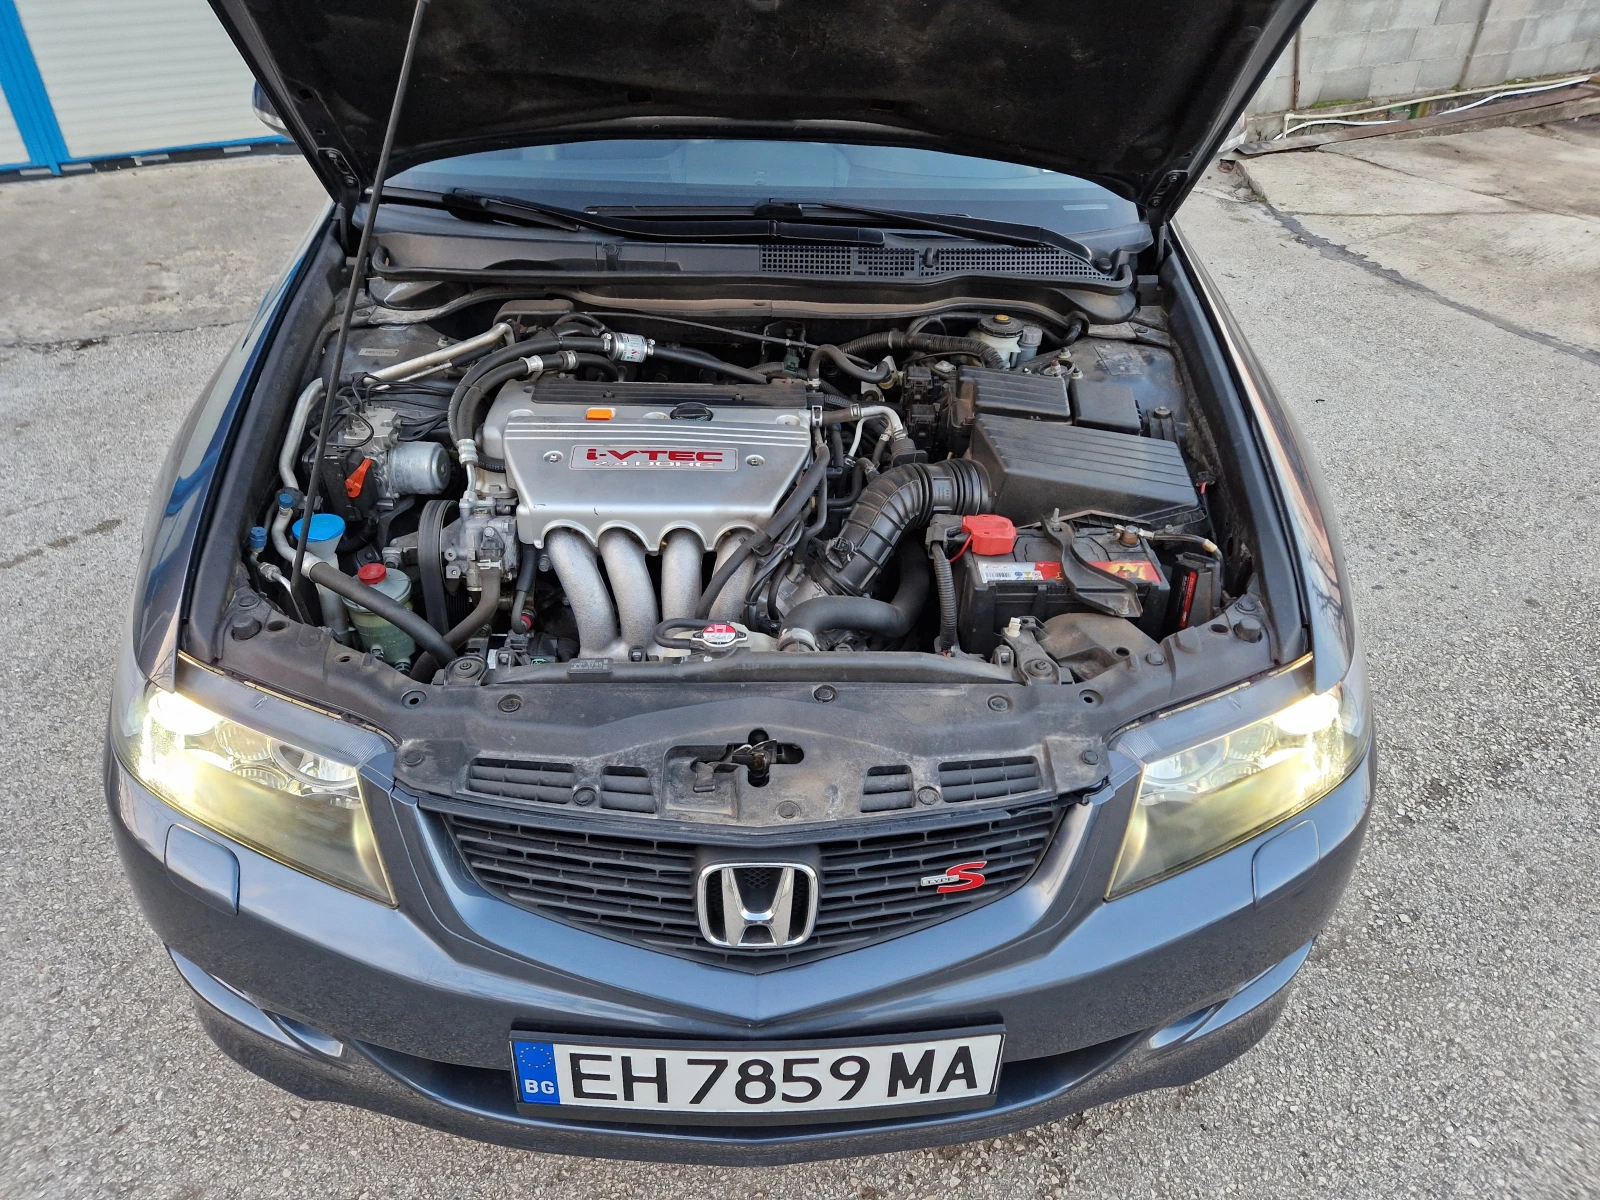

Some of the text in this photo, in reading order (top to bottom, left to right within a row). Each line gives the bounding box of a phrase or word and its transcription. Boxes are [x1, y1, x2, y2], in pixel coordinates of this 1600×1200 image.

[586, 448, 723, 462] i-VTEC
[937, 861, 987, 893] S
[524, 1078, 555, 1095] BG
